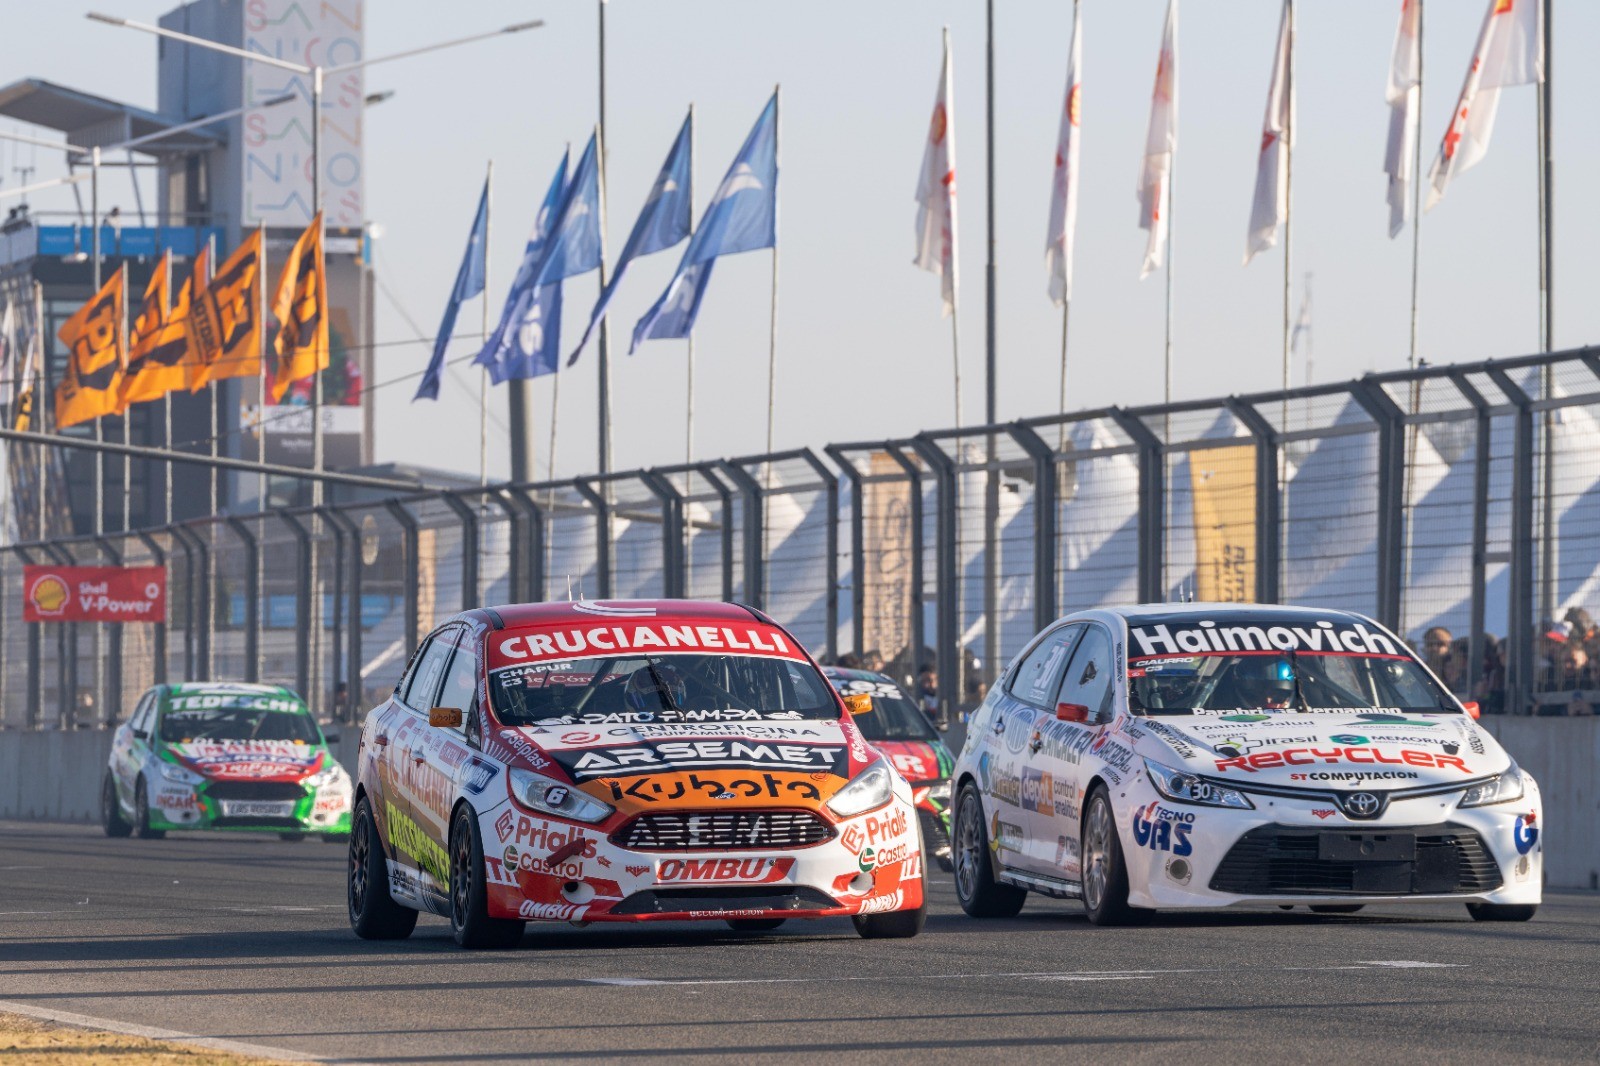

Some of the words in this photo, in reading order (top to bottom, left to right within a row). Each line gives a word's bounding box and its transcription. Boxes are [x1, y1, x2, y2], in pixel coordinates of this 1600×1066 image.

[79, 582, 108, 594] Shell
[79, 596, 153, 613] V-Power
[499, 624, 790, 659] CRUCIANELLI
[1131, 620, 1399, 656] Haimovich
[498, 662, 574, 680] CHAPUR
[1135, 657, 1196, 667] CIAURRO
[500, 677, 524, 688] C3
[169, 695, 300, 712] TEDESCHI
[606, 722, 822, 738] CENTROFICINA
[1370, 735, 1461, 747] MEMORIAS
[573, 741, 843, 770] ARSEMET
[610, 773, 822, 802] Kubota
[1193, 783, 1211, 799] 30
[545, 787, 568, 807] 6
[1154, 805, 1196, 823] TECNO
[1132, 803, 1193, 857] GAS
[656, 857, 763, 882] OMBU
[519, 898, 574, 921] OMBU
